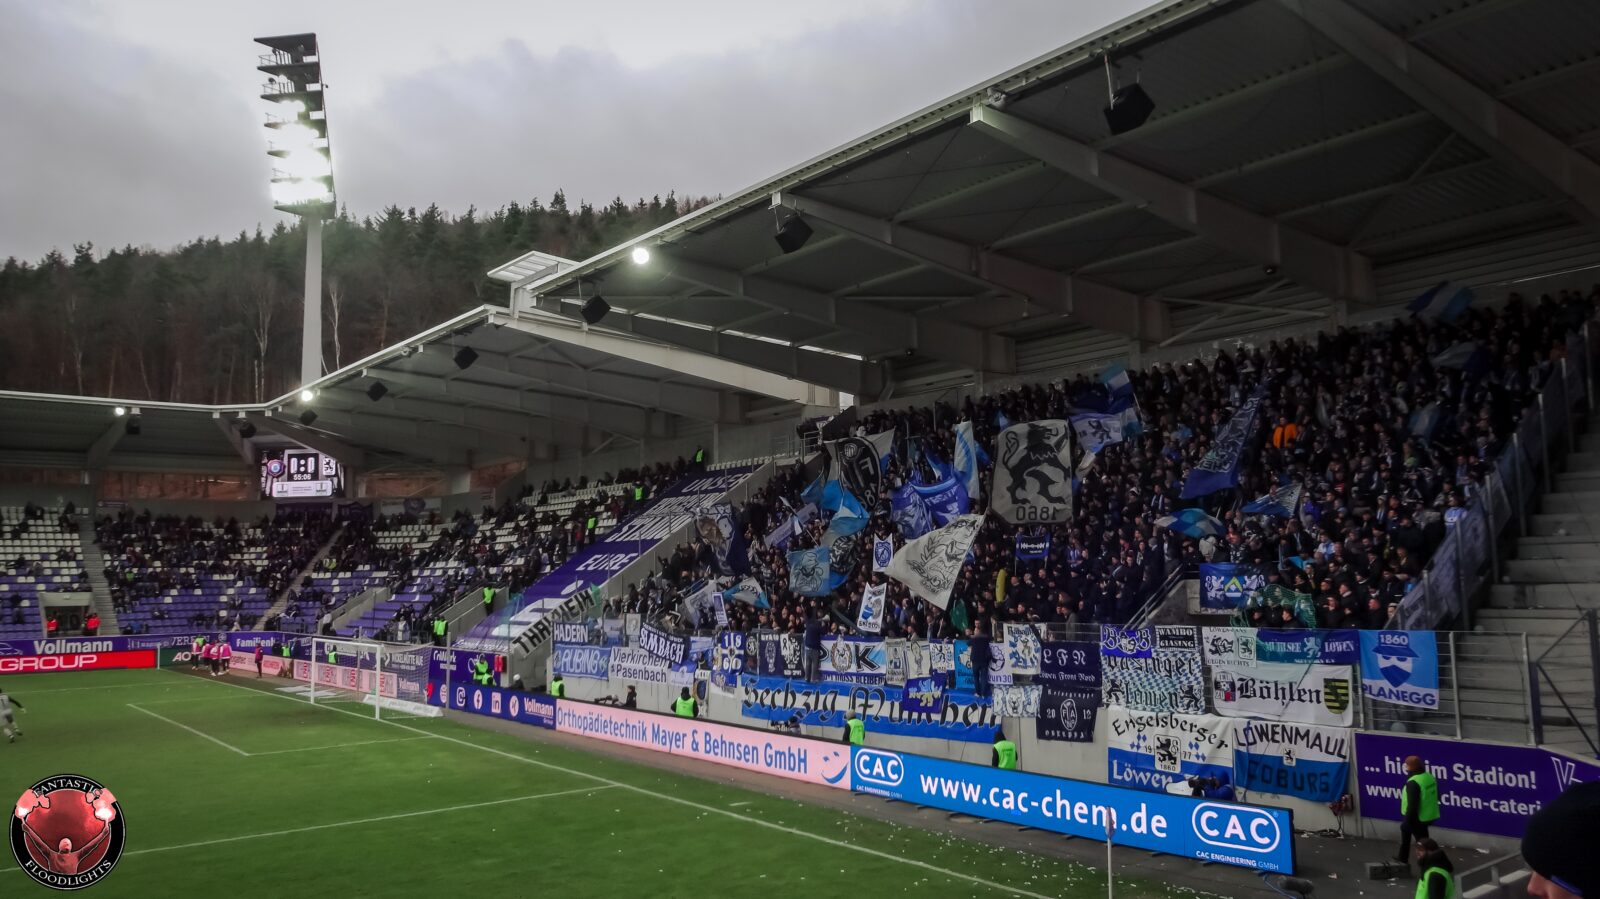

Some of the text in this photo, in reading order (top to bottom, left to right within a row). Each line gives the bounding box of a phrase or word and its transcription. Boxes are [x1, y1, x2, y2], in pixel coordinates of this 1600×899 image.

[290, 457, 315, 473] 1:1
[681, 472, 753, 493] UNSER
[575, 553, 639, 571] EURE
[553, 623, 588, 642] HADERN
[1159, 628, 1193, 637] WAMBO
[1380, 634, 1409, 646] 1860
[34, 639, 113, 655] Vollmann
[640, 627, 684, 664] SIMBACH
[0, 654, 97, 671] GROUP
[616, 665, 667, 683] Pasenbach
[1237, 677, 1322, 706] Böhlen
[1361, 683, 1437, 707] PLANEGG
[524, 697, 554, 717] Vollmann
[557, 706, 808, 774] Orthopädietechnik Mayer & Behnsen GmbH
[1112, 712, 1229, 750] Engelsberger
[1233, 722, 1348, 760] LÖWENMAUL
[859, 754, 899, 781] CAC
[1384, 756, 1408, 776] hie
[1459, 765, 1538, 790] Stadion!
[920, 773, 1168, 839] www.cac-chem.de
[1200, 810, 1271, 845] CAC
[1195, 850, 1279, 871] CAC ENGINEERING GMBH
